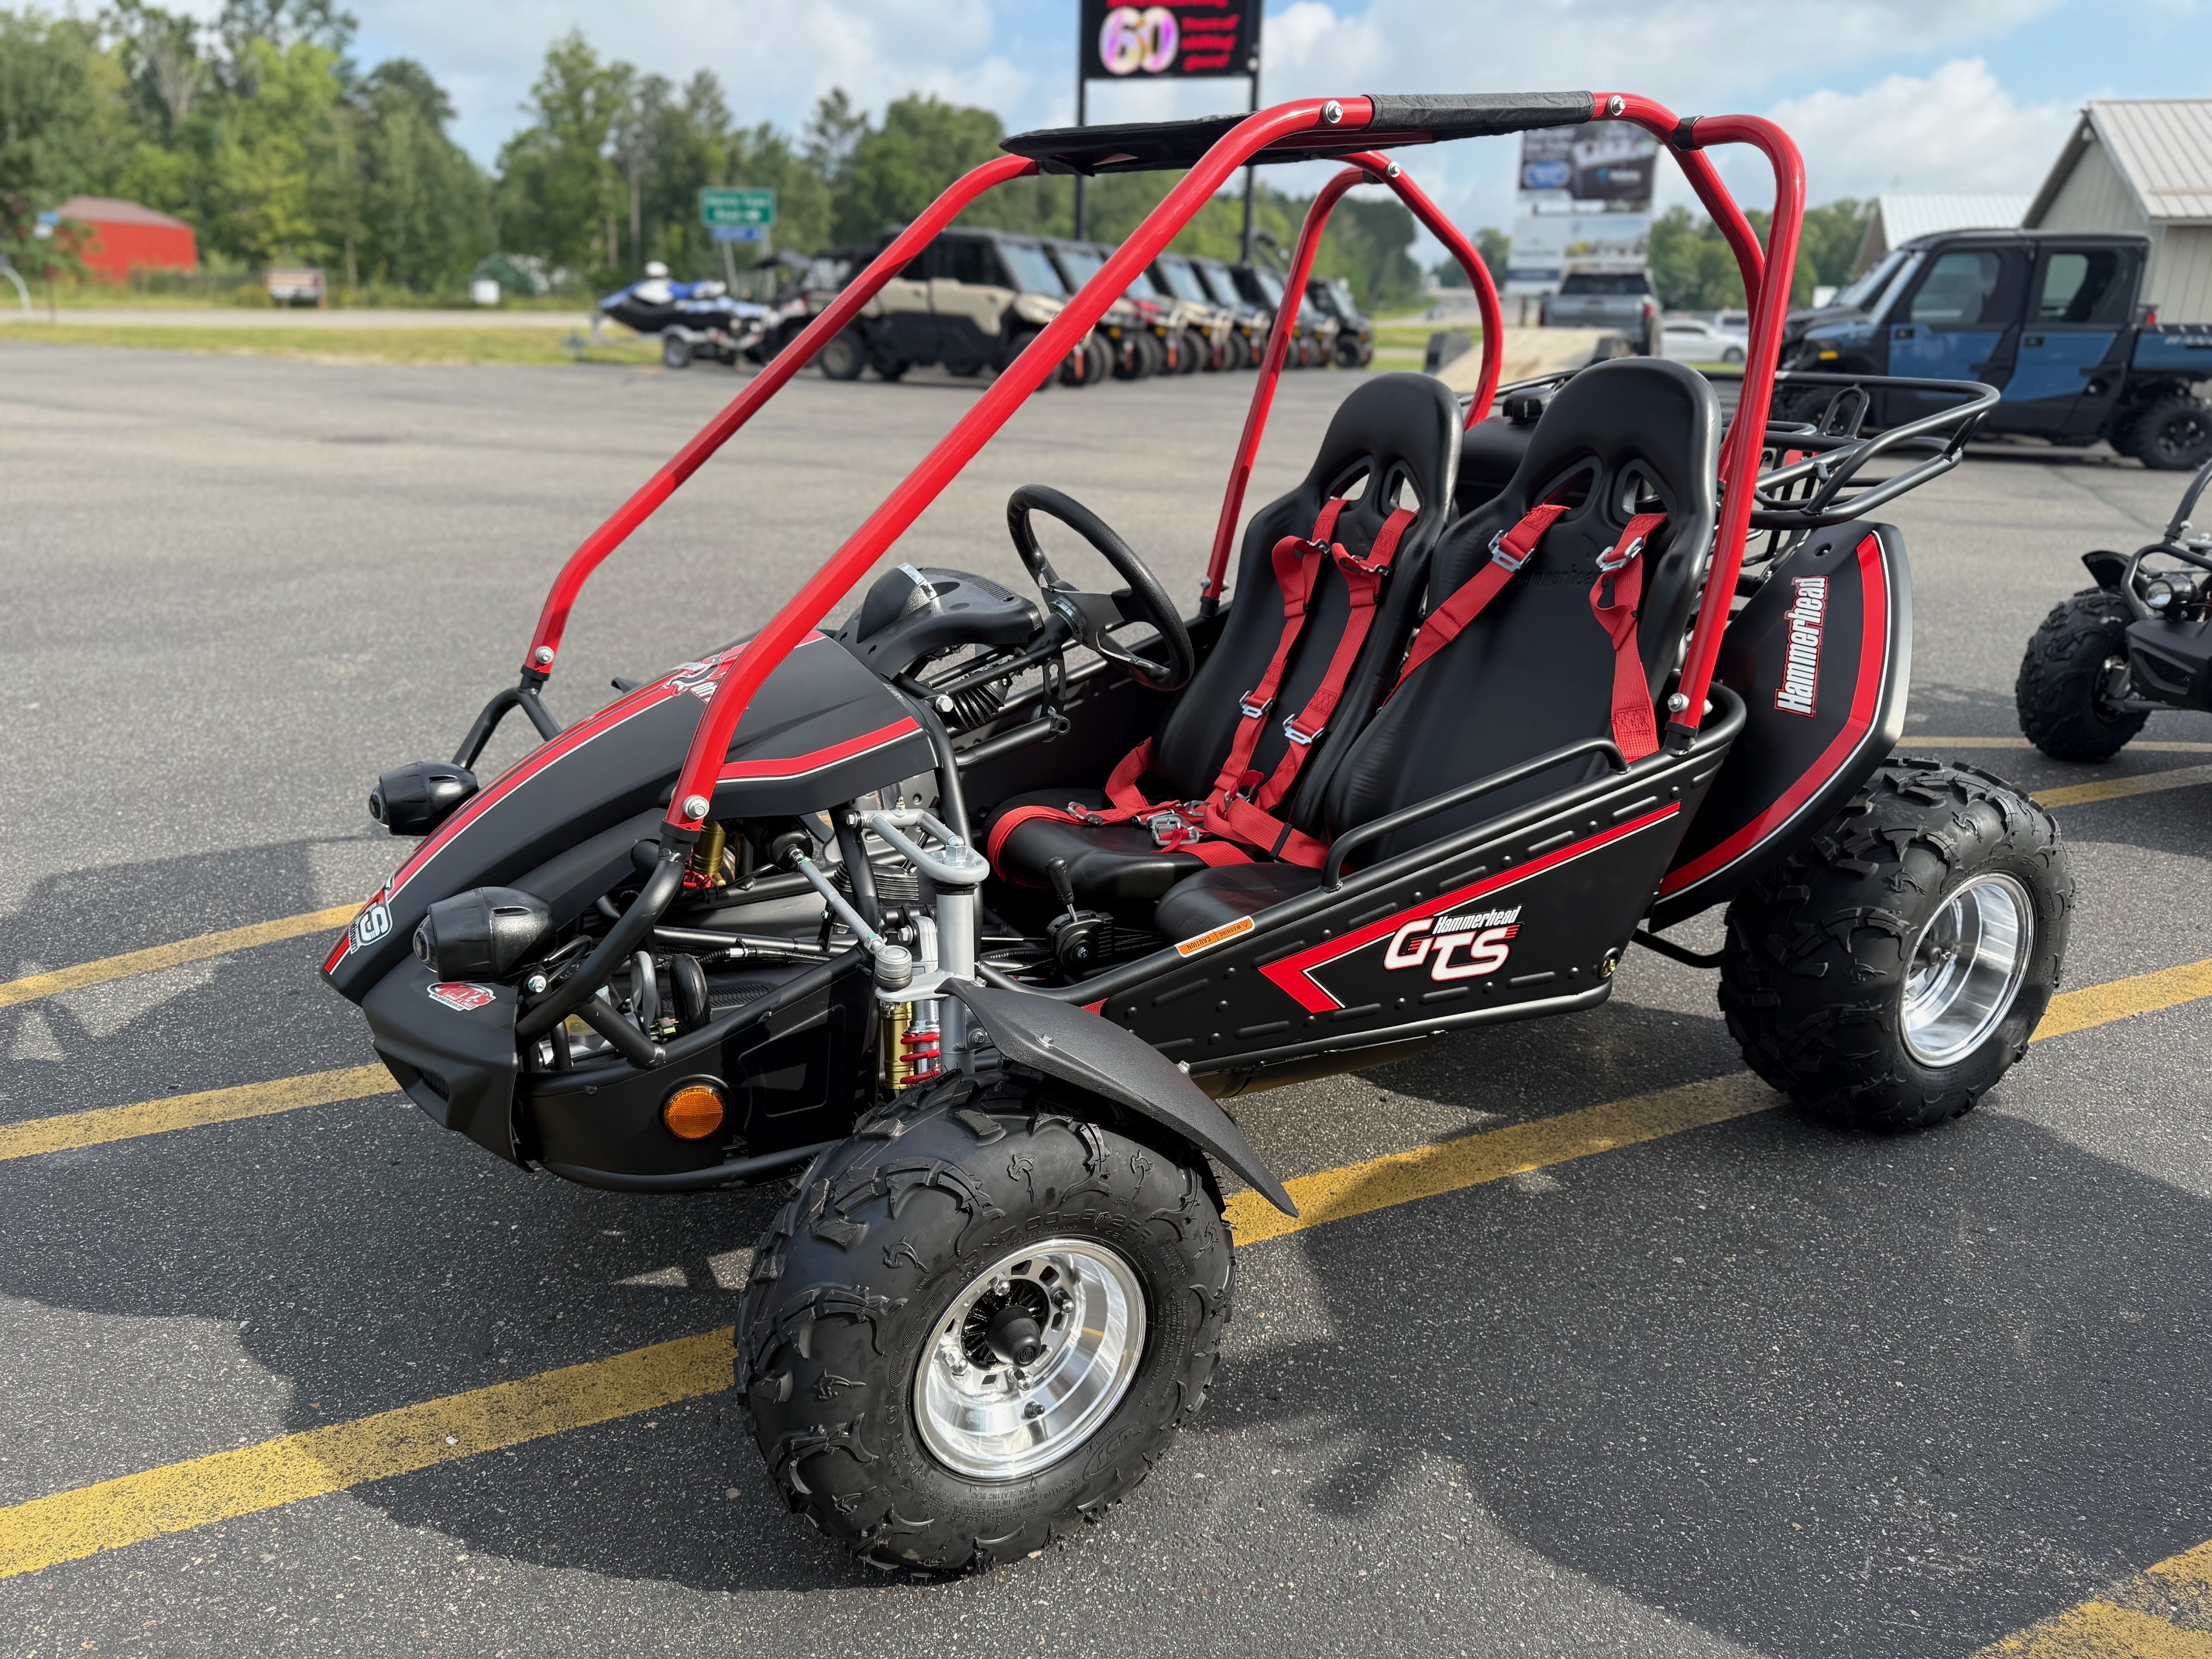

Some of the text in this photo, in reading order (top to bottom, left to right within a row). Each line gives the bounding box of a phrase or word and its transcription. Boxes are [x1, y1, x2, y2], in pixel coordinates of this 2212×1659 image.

[1098, 6, 1179, 75] 60
[1777, 578, 1826, 714] Hammerhead
[1432, 904, 1522, 935] Hammerhead
[1186, 936, 1211, 950] CAUTION
[1383, 918, 1516, 981] GTS
[1156, 1245, 1177, 1278] NYLON
[884, 1276, 956, 1389] CST
[988, 1489, 1016, 1500] SEATING
[1039, 1474, 1079, 1502] WARNING
[1025, 1505, 1039, 1516] SEE
